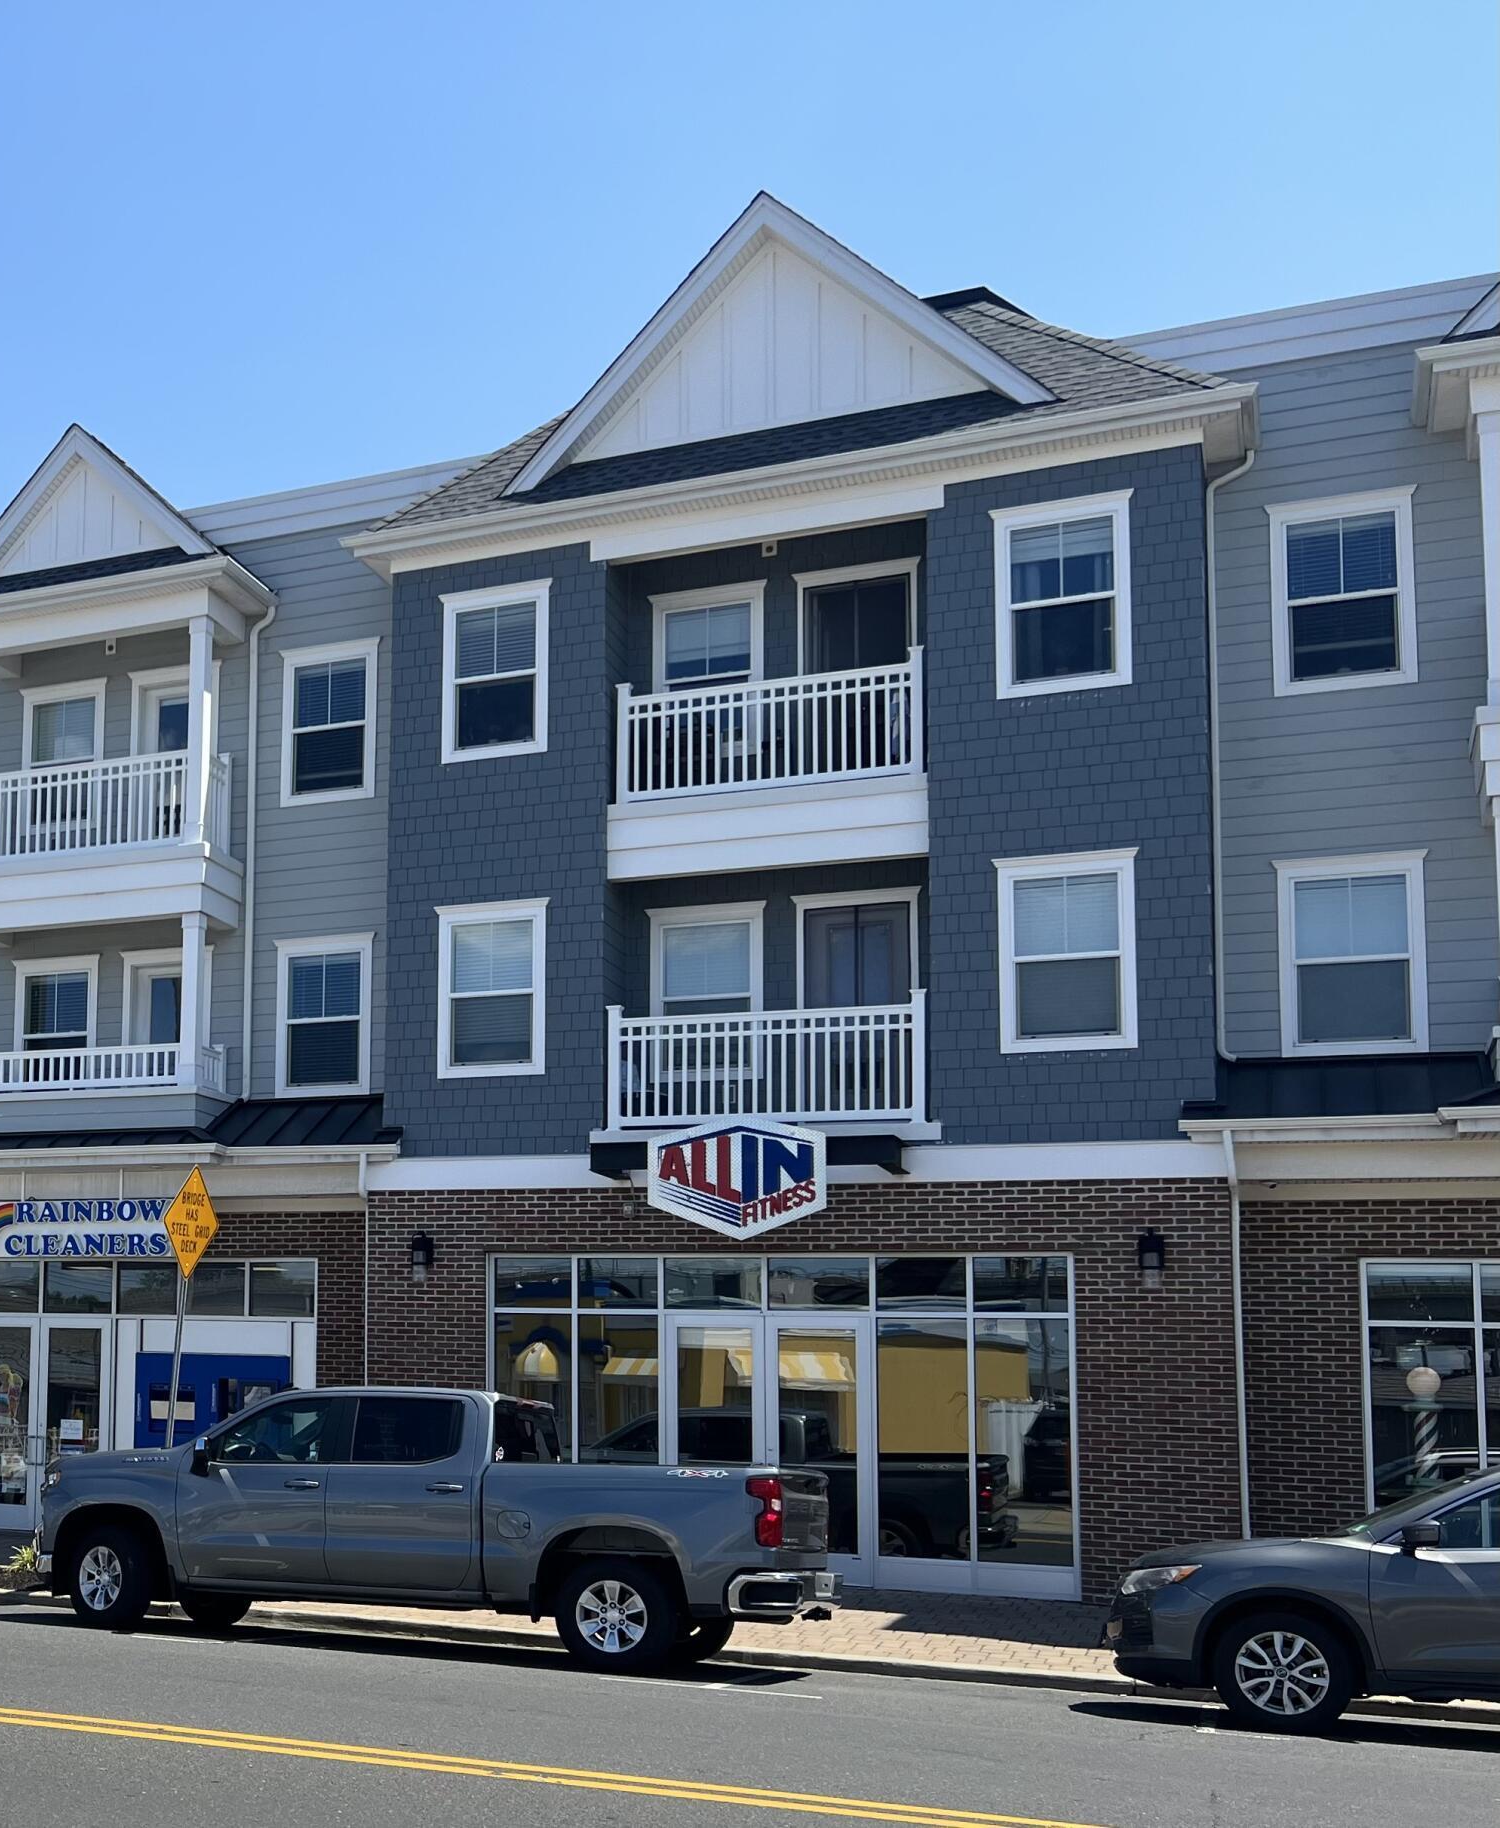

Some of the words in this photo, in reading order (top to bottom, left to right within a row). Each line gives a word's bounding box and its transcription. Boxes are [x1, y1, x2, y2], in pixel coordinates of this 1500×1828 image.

[659, 1135, 741, 1204] ALL
[741, 1134, 814, 1204] IN
[182, 1192, 206, 1207] BRIDGE
[742, 1180, 816, 1228] FITNESS
[16, 1200, 167, 1224] RAINBOW
[185, 1209, 199, 1222] HAS
[171, 1223, 190, 1237] STEEL
[194, 1225, 210, 1239] GRID
[4, 1233, 167, 1256] CLEANERS
[181, 1240, 197, 1253] DECK
